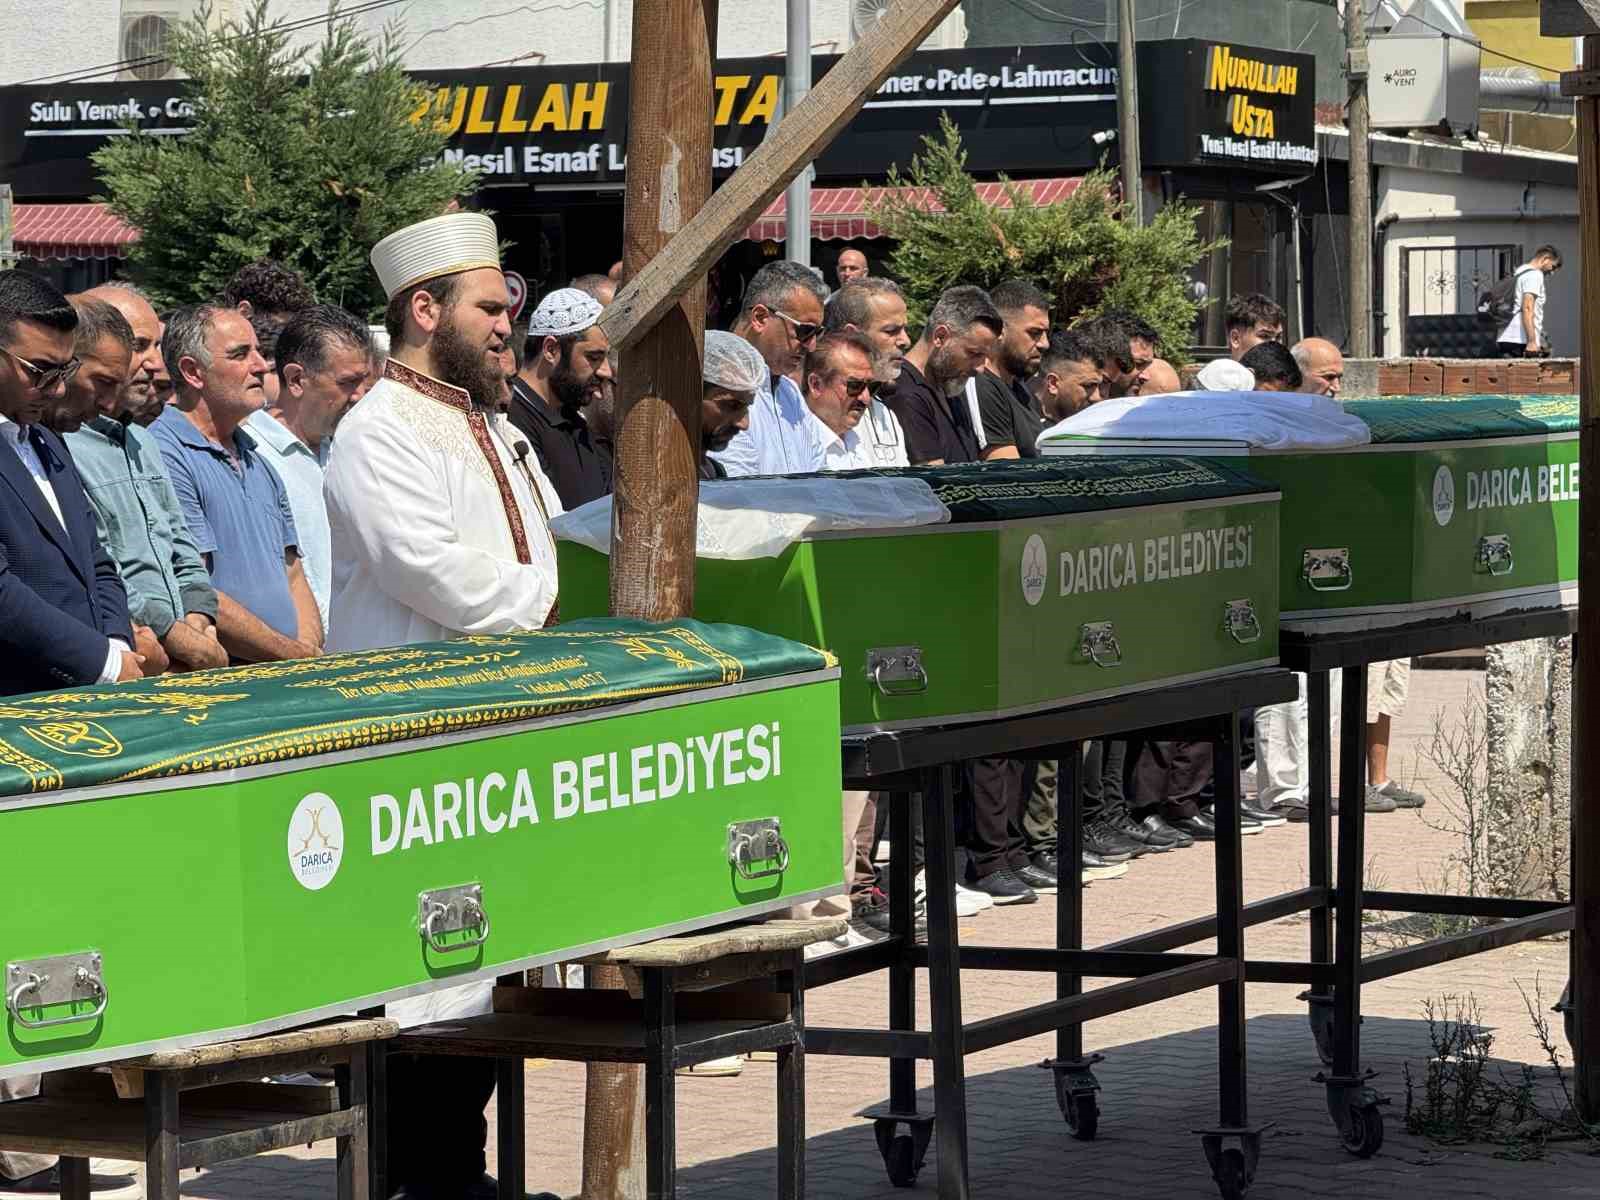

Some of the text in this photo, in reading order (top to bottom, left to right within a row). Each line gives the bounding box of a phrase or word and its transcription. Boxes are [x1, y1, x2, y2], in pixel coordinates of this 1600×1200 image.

[937, 67, 987, 91] Pide
[1001, 64, 1119, 88] Lahmacun
[1210, 45, 1298, 96] NURULLAH
[1393, 78, 1416, 87] VENT
[29, 100, 72, 122] Sulu
[76, 98, 146, 121] Yemek
[1232, 93, 1275, 139] USTA
[1201, 134, 1224, 155] Yeni
[523, 147, 601, 173] Esnaf
[1468, 466, 1532, 511] DARICA
[1059, 542, 1138, 597] DARICA
[370, 721, 781, 856] DARICA BELEDİYESİ
[301, 851, 333, 868] DARICA
